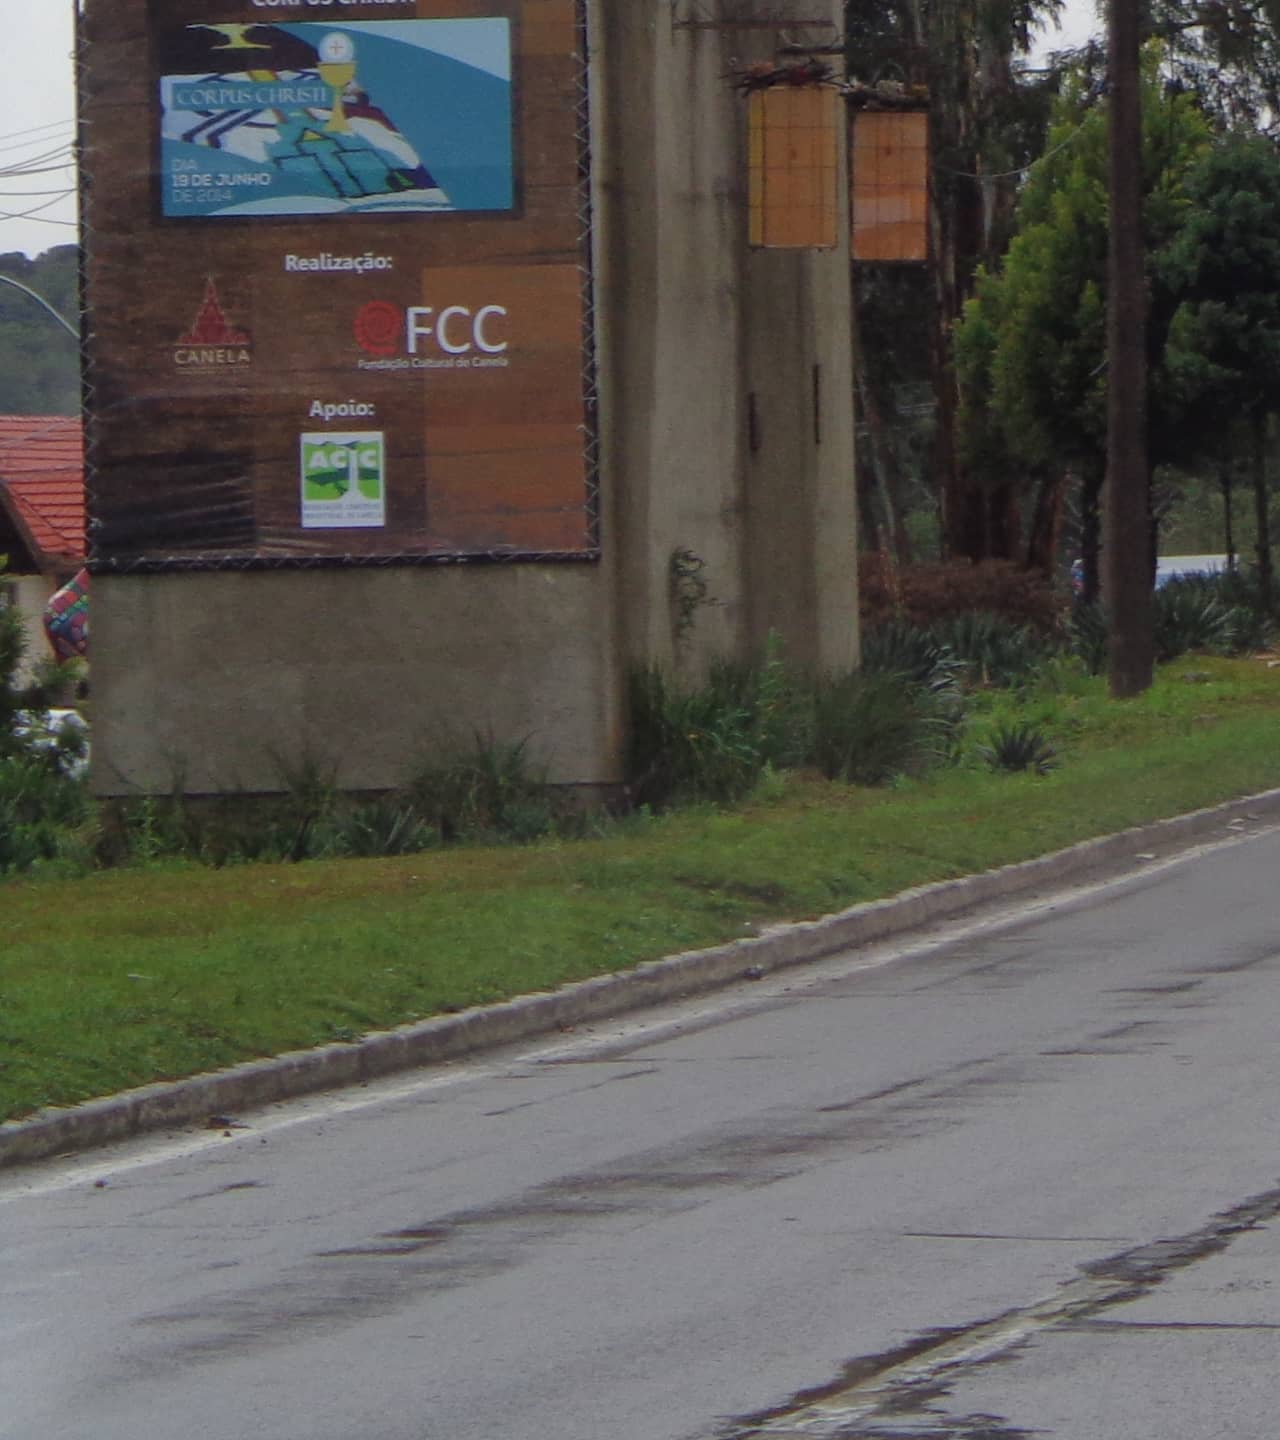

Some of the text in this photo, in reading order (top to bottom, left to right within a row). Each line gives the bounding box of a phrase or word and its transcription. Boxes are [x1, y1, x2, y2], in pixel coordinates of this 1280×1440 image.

[177, 87, 326, 105] CORPUS CHRISTI
[192, 174, 211, 186] DE
[215, 172, 271, 186] JUNHO
[172, 190, 193, 202] DE
[285, 252, 392, 273] Realização:
[406, 305, 507, 354] FCC
[174, 349, 250, 364] CANELA
[309, 400, 375, 420] Apoio:
